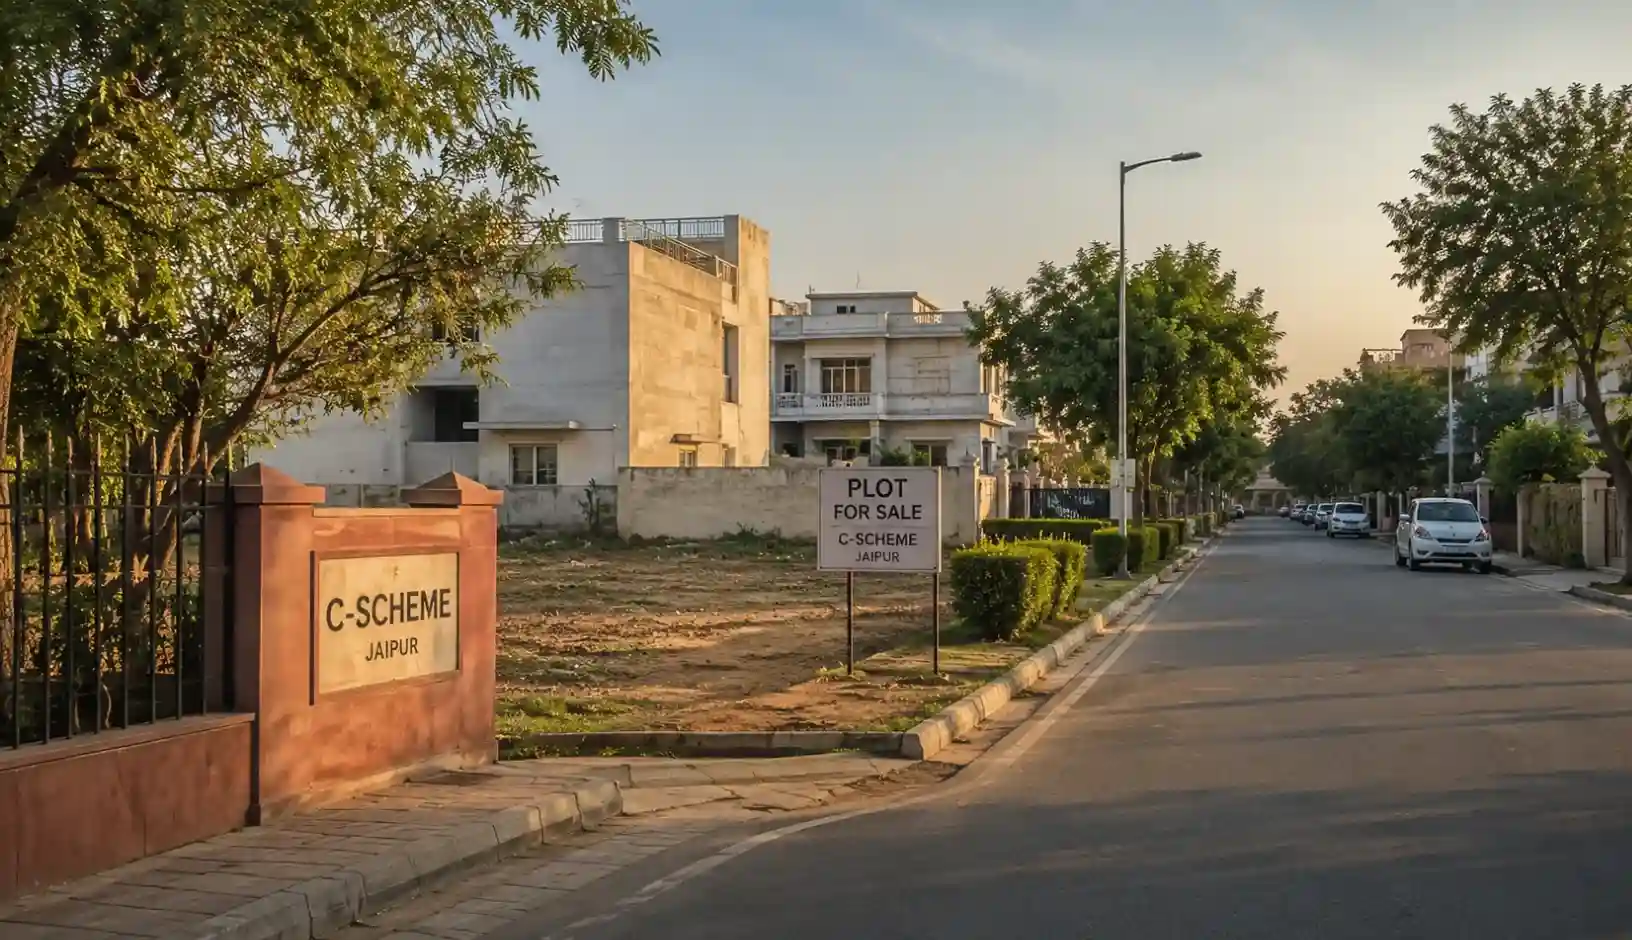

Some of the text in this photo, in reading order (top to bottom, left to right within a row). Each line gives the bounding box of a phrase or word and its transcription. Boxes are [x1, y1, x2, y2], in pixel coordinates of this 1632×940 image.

[848, 478, 908, 498] PLOT
[834, 504, 922, 520] FOR SALE
[838, 532, 918, 546] C-SCHEME
[855, 551, 900, 563] JAIPUR
[326, 588, 452, 632] C-SCHEME
[365, 637, 419, 662] JAIPUR
